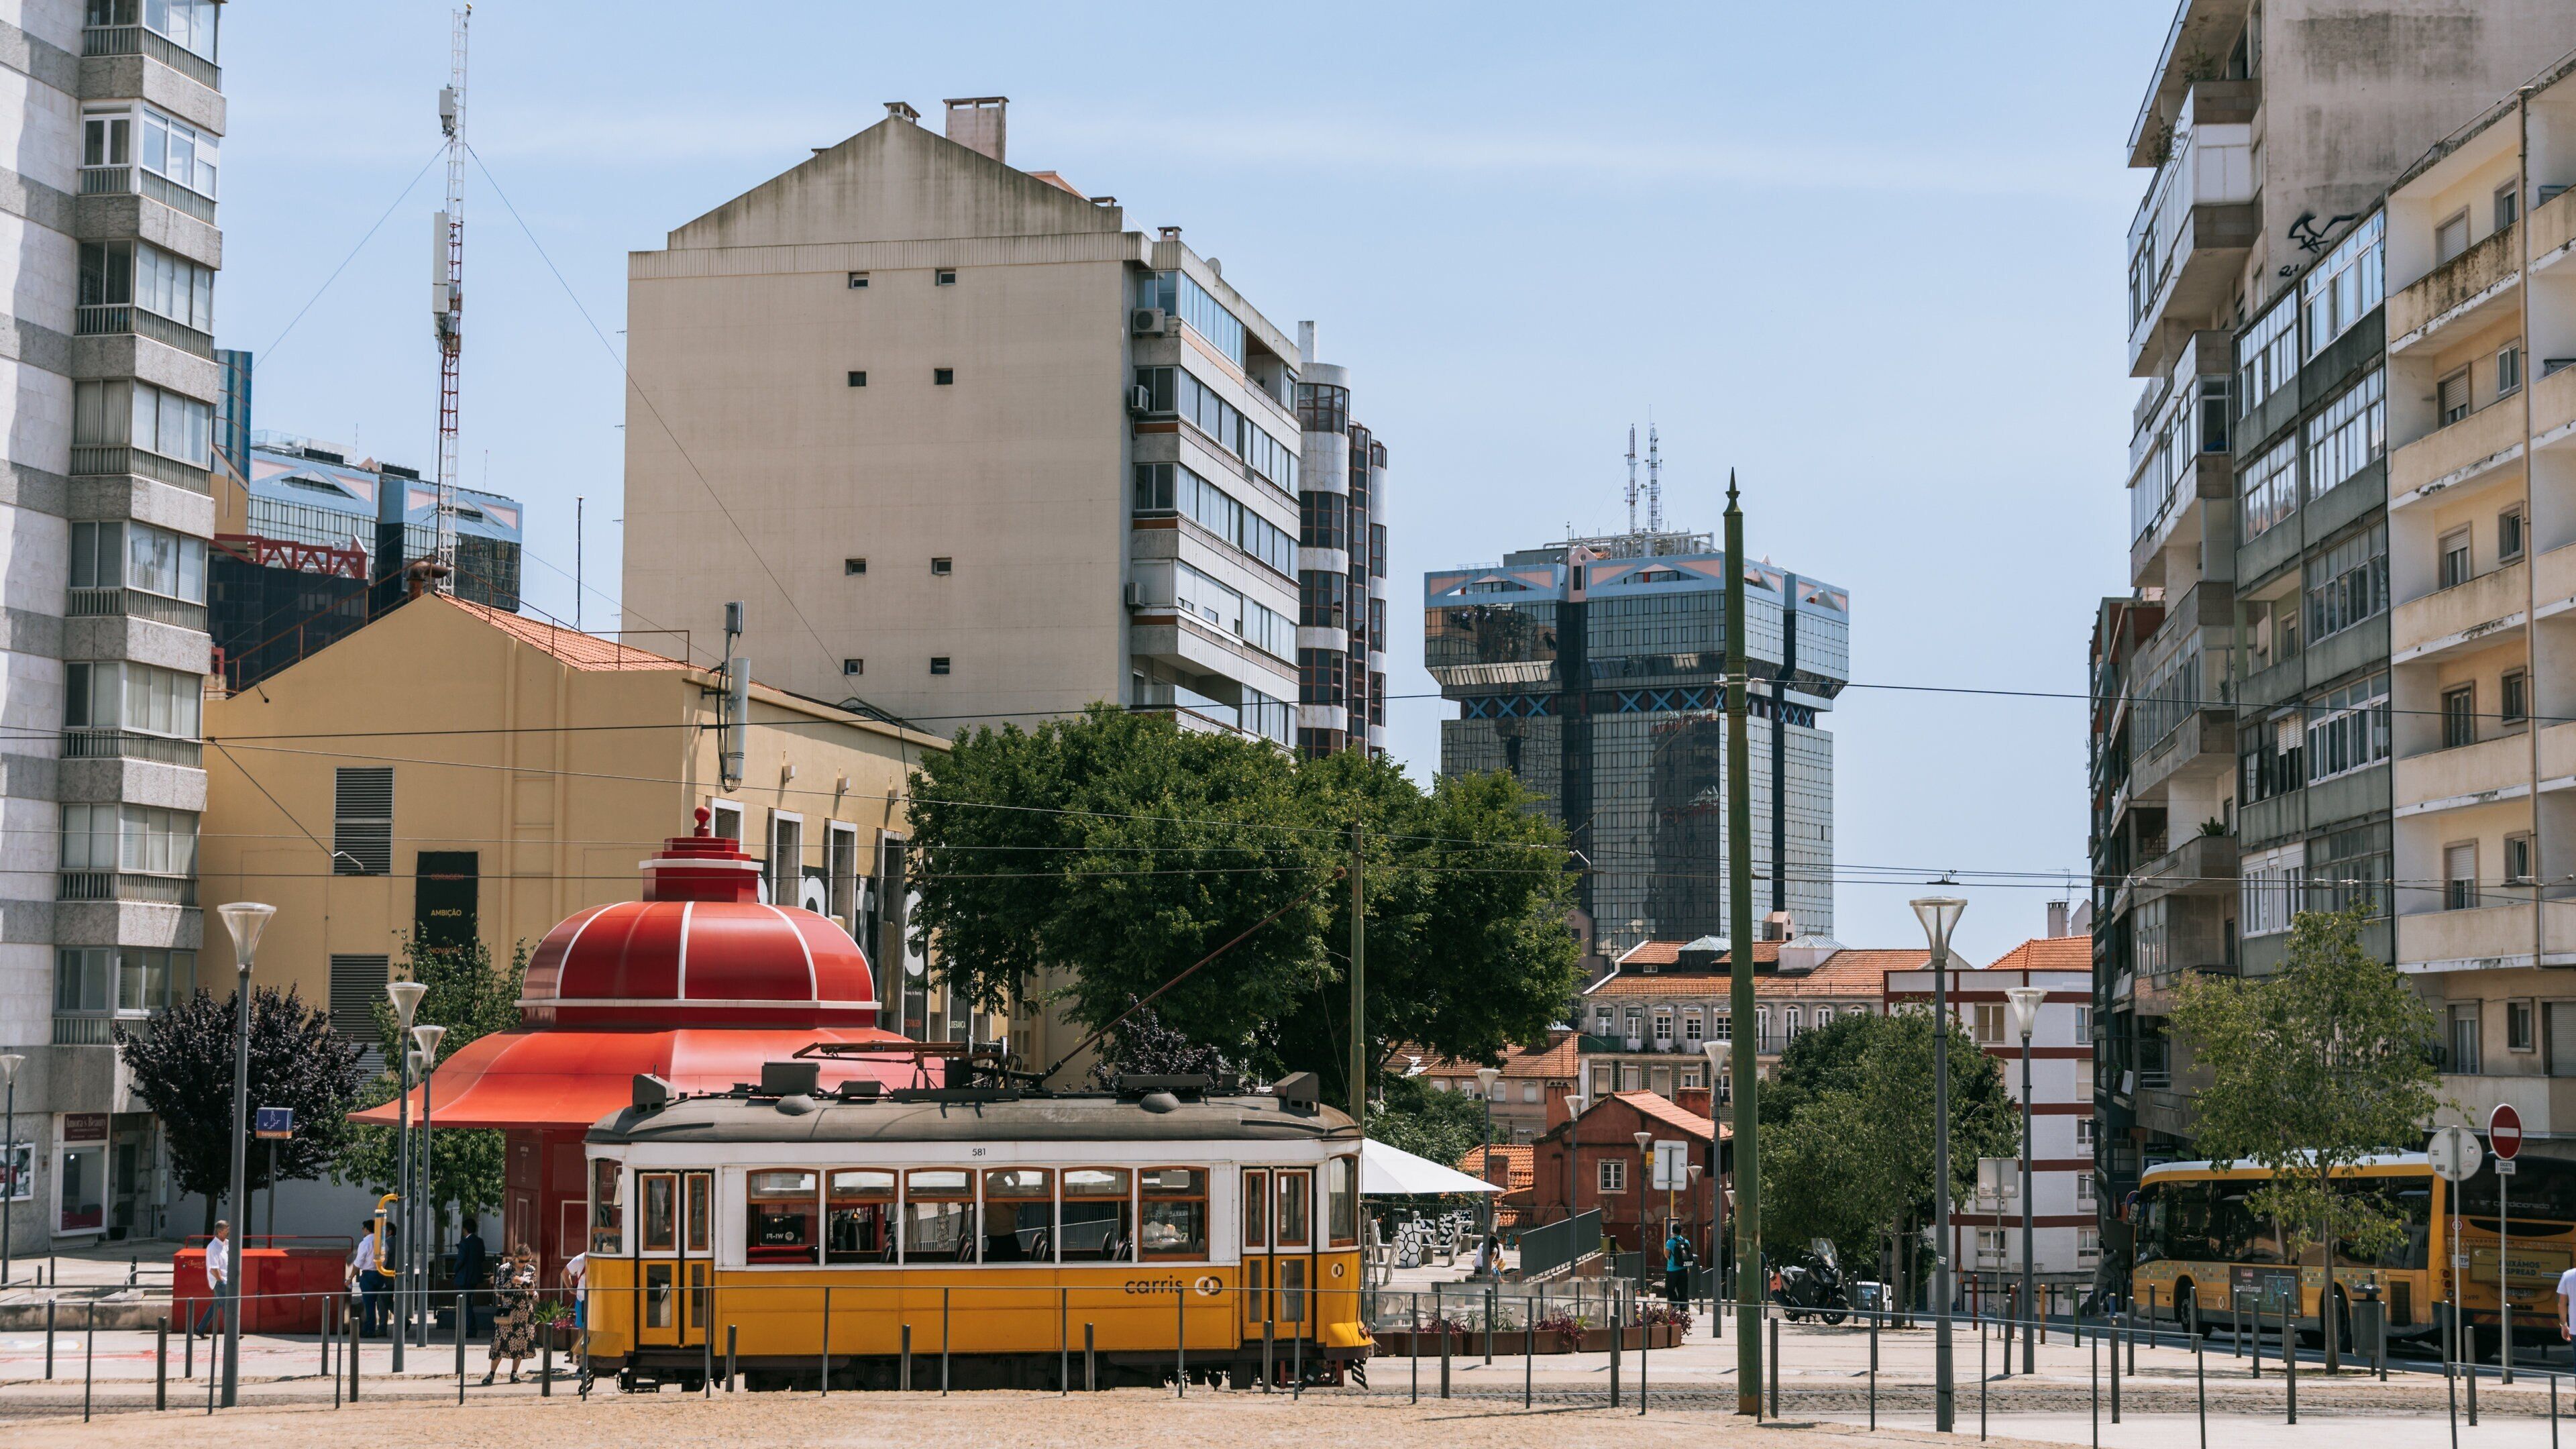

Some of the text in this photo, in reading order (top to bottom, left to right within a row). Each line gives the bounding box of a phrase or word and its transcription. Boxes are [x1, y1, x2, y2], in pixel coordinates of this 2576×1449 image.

[431, 908, 462, 918] AMBIÇÃO
[429, 947, 463, 955] NOVAÇÃO
[88, 1116, 106, 1129] Beauty
[972, 1148, 985, 1156] 581
[2505, 1268, 2536, 1276] SPREAD
[1125, 1275, 1183, 1294] carris
